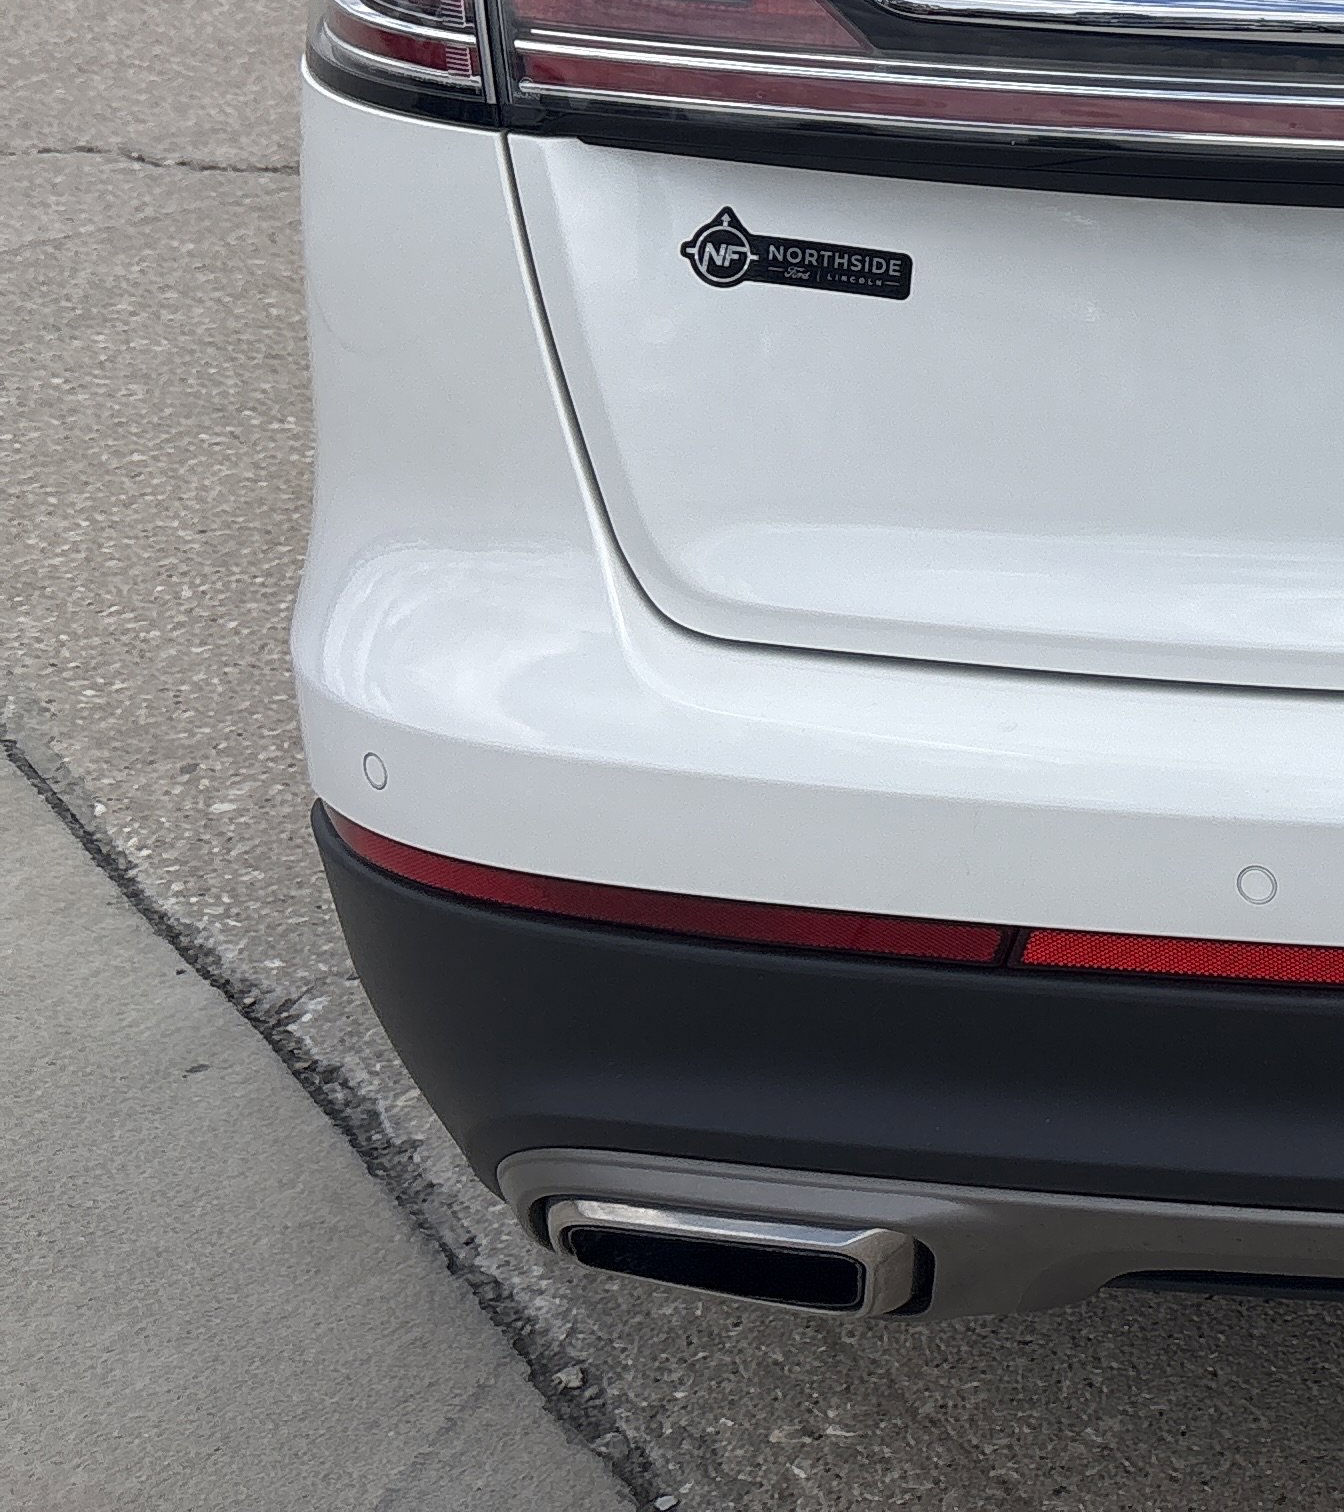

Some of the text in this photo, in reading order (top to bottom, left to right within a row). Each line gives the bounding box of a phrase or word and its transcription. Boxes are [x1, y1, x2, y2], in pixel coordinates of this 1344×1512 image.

[768, 244, 902, 276] NORTHSIDE
[784, 265, 883, 286] Ford LINCOLN
